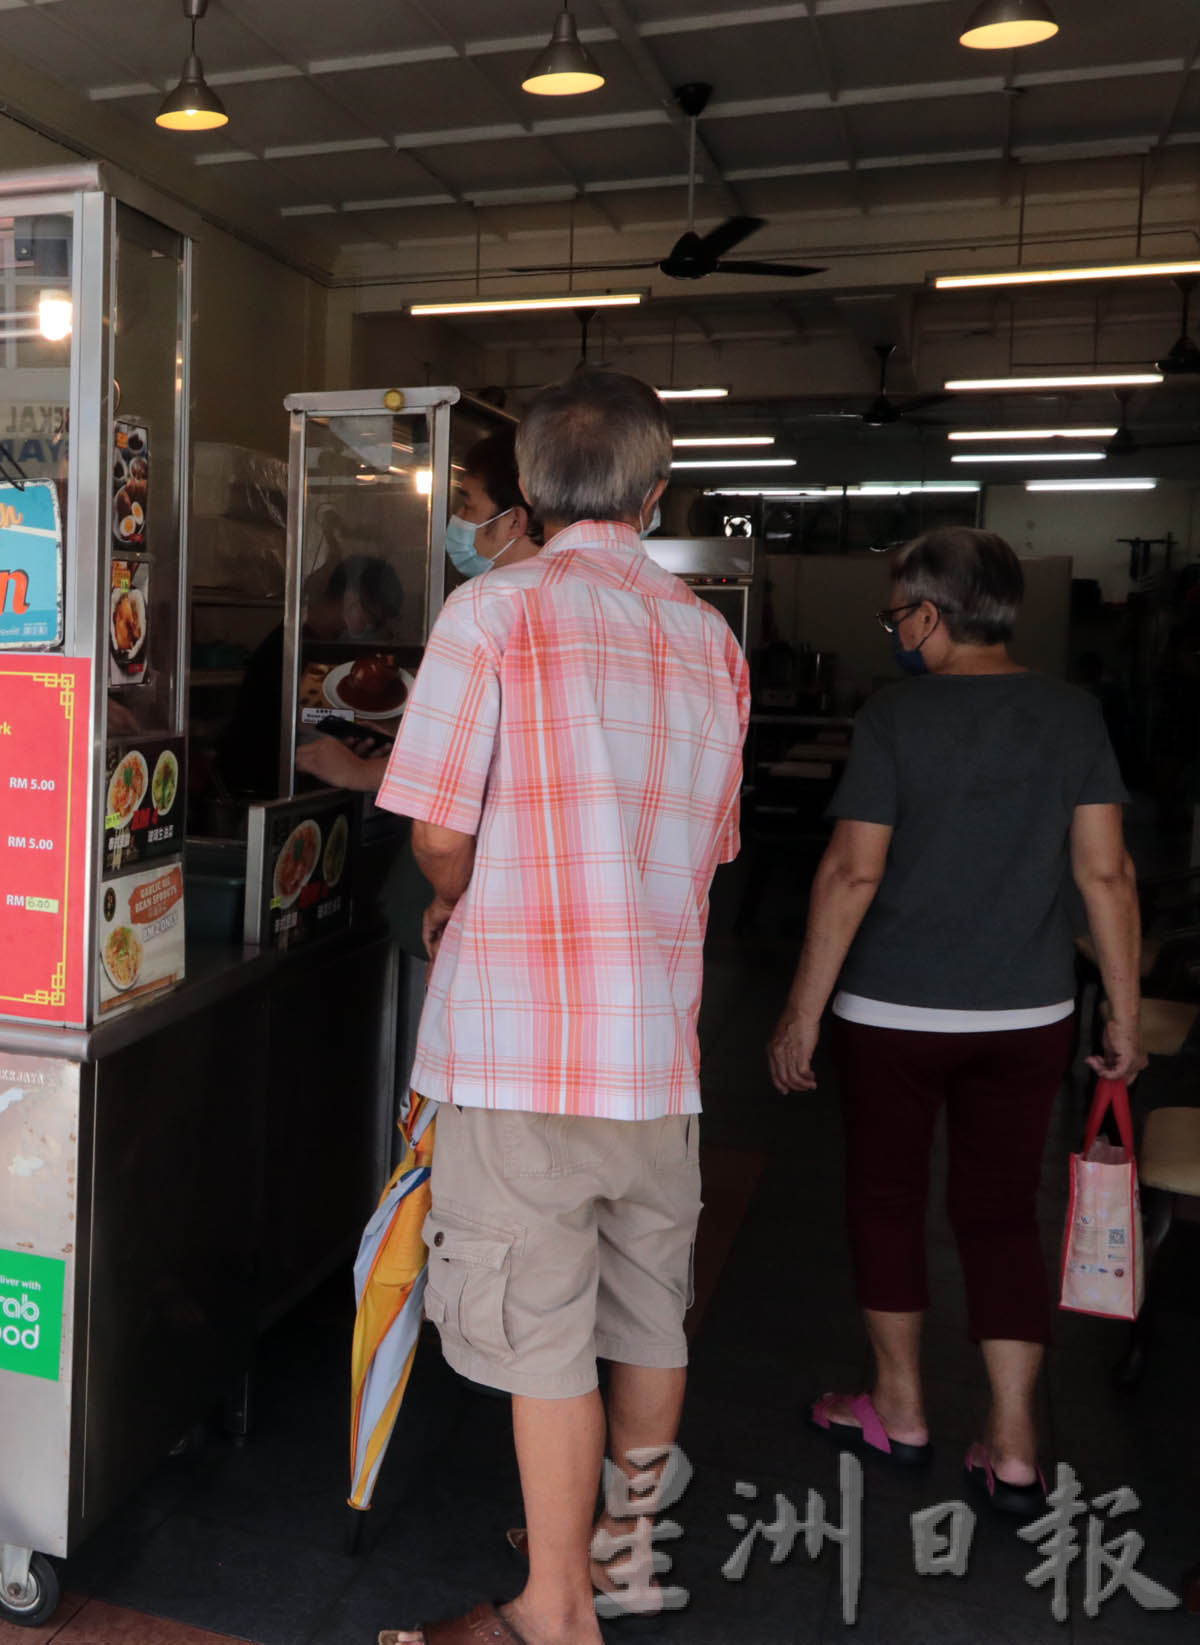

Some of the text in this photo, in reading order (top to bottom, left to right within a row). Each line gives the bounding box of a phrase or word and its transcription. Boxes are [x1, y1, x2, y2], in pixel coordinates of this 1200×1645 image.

[10, 777, 55, 790] RM 5.00
[8, 836, 53, 850] RM 5.00
[7, 895, 26, 906] RM
[21, 1278, 42, 1292] with
